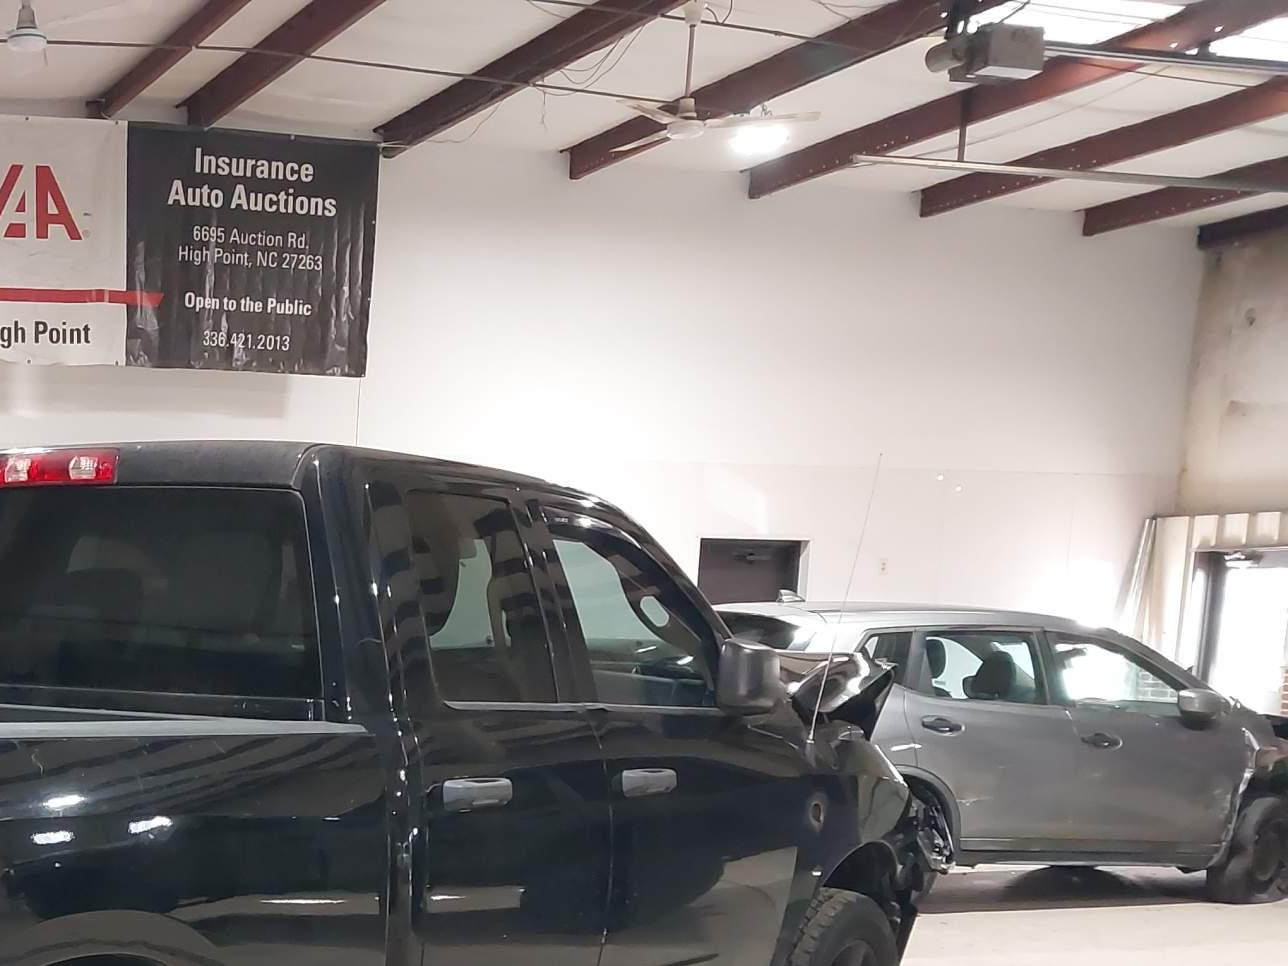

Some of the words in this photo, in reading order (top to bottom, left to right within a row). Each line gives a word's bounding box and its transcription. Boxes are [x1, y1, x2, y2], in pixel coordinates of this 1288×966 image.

[194, 147, 314, 183] Insurance
[167, 179, 224, 209] Auto
[230, 183, 337, 217] Auctions
[193, 225, 225, 244] 6695
[229, 228, 283, 248] Auction
[287, 231, 310, 250] Rd.
[178, 245, 210, 266] High
[214, 247, 253, 269] Point,
[256, 250, 278, 269] NC
[281, 252, 323, 271] 27263
[184, 291, 220, 312] Open
[223, 297, 237, 312] to
[240, 296, 263, 314] the
[267, 298, 312, 316] Public
[33, 320, 91, 345] Point
[202, 330, 291, 351] 336.421.2013
